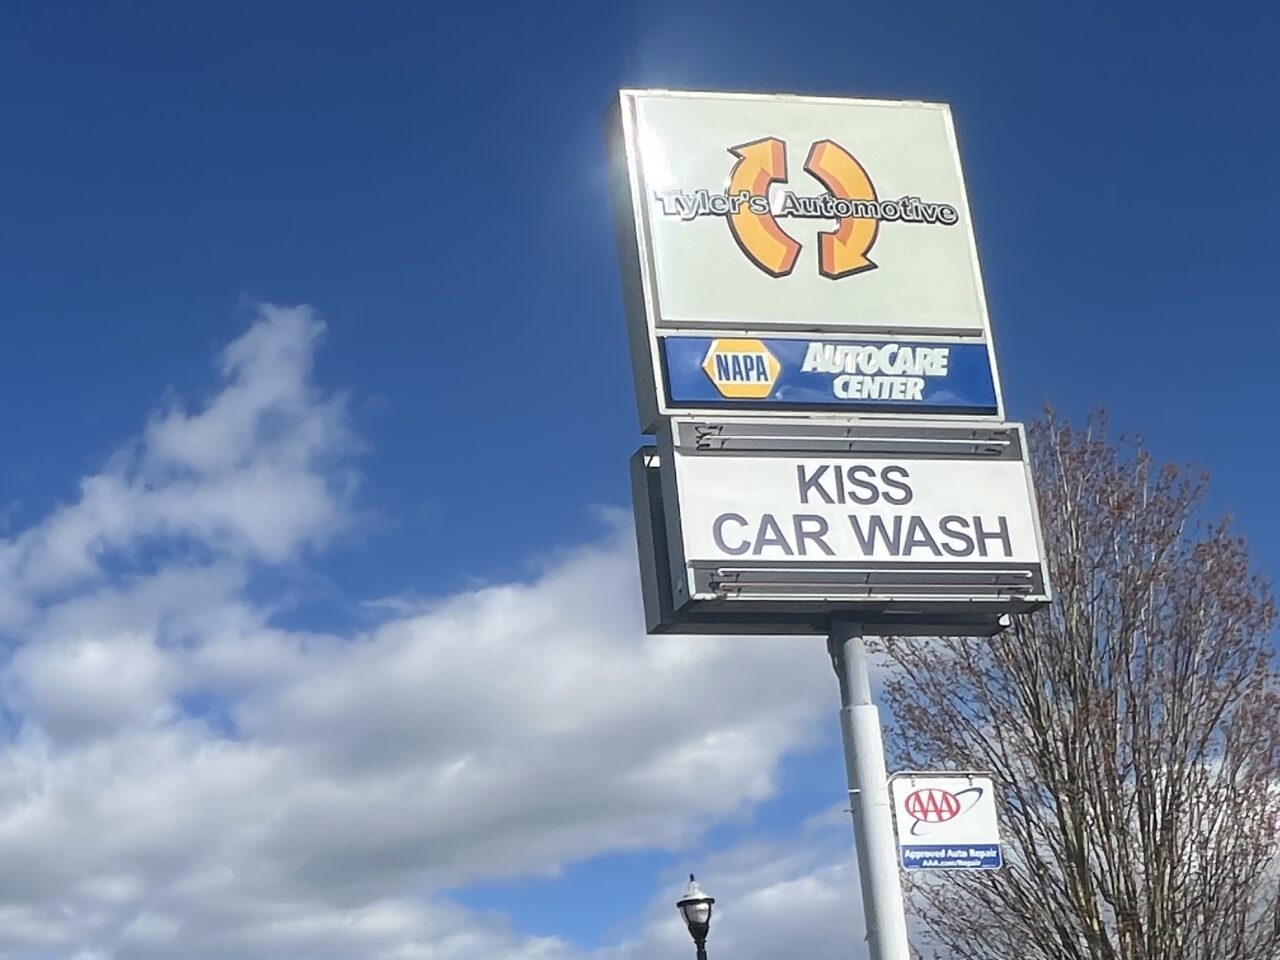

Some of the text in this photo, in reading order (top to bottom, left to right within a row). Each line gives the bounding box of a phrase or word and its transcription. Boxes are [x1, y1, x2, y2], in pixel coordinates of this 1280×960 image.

[655, 189, 959, 225] Tyler's Automotive
[716, 353, 769, 382] NAPA
[832, 374, 926, 401] CENTER
[796, 464, 913, 506] KISS
[712, 513, 1013, 557] CAR WASH
[912, 790, 956, 822] AAA
[905, 848, 997, 859] Approved Auto Repair
